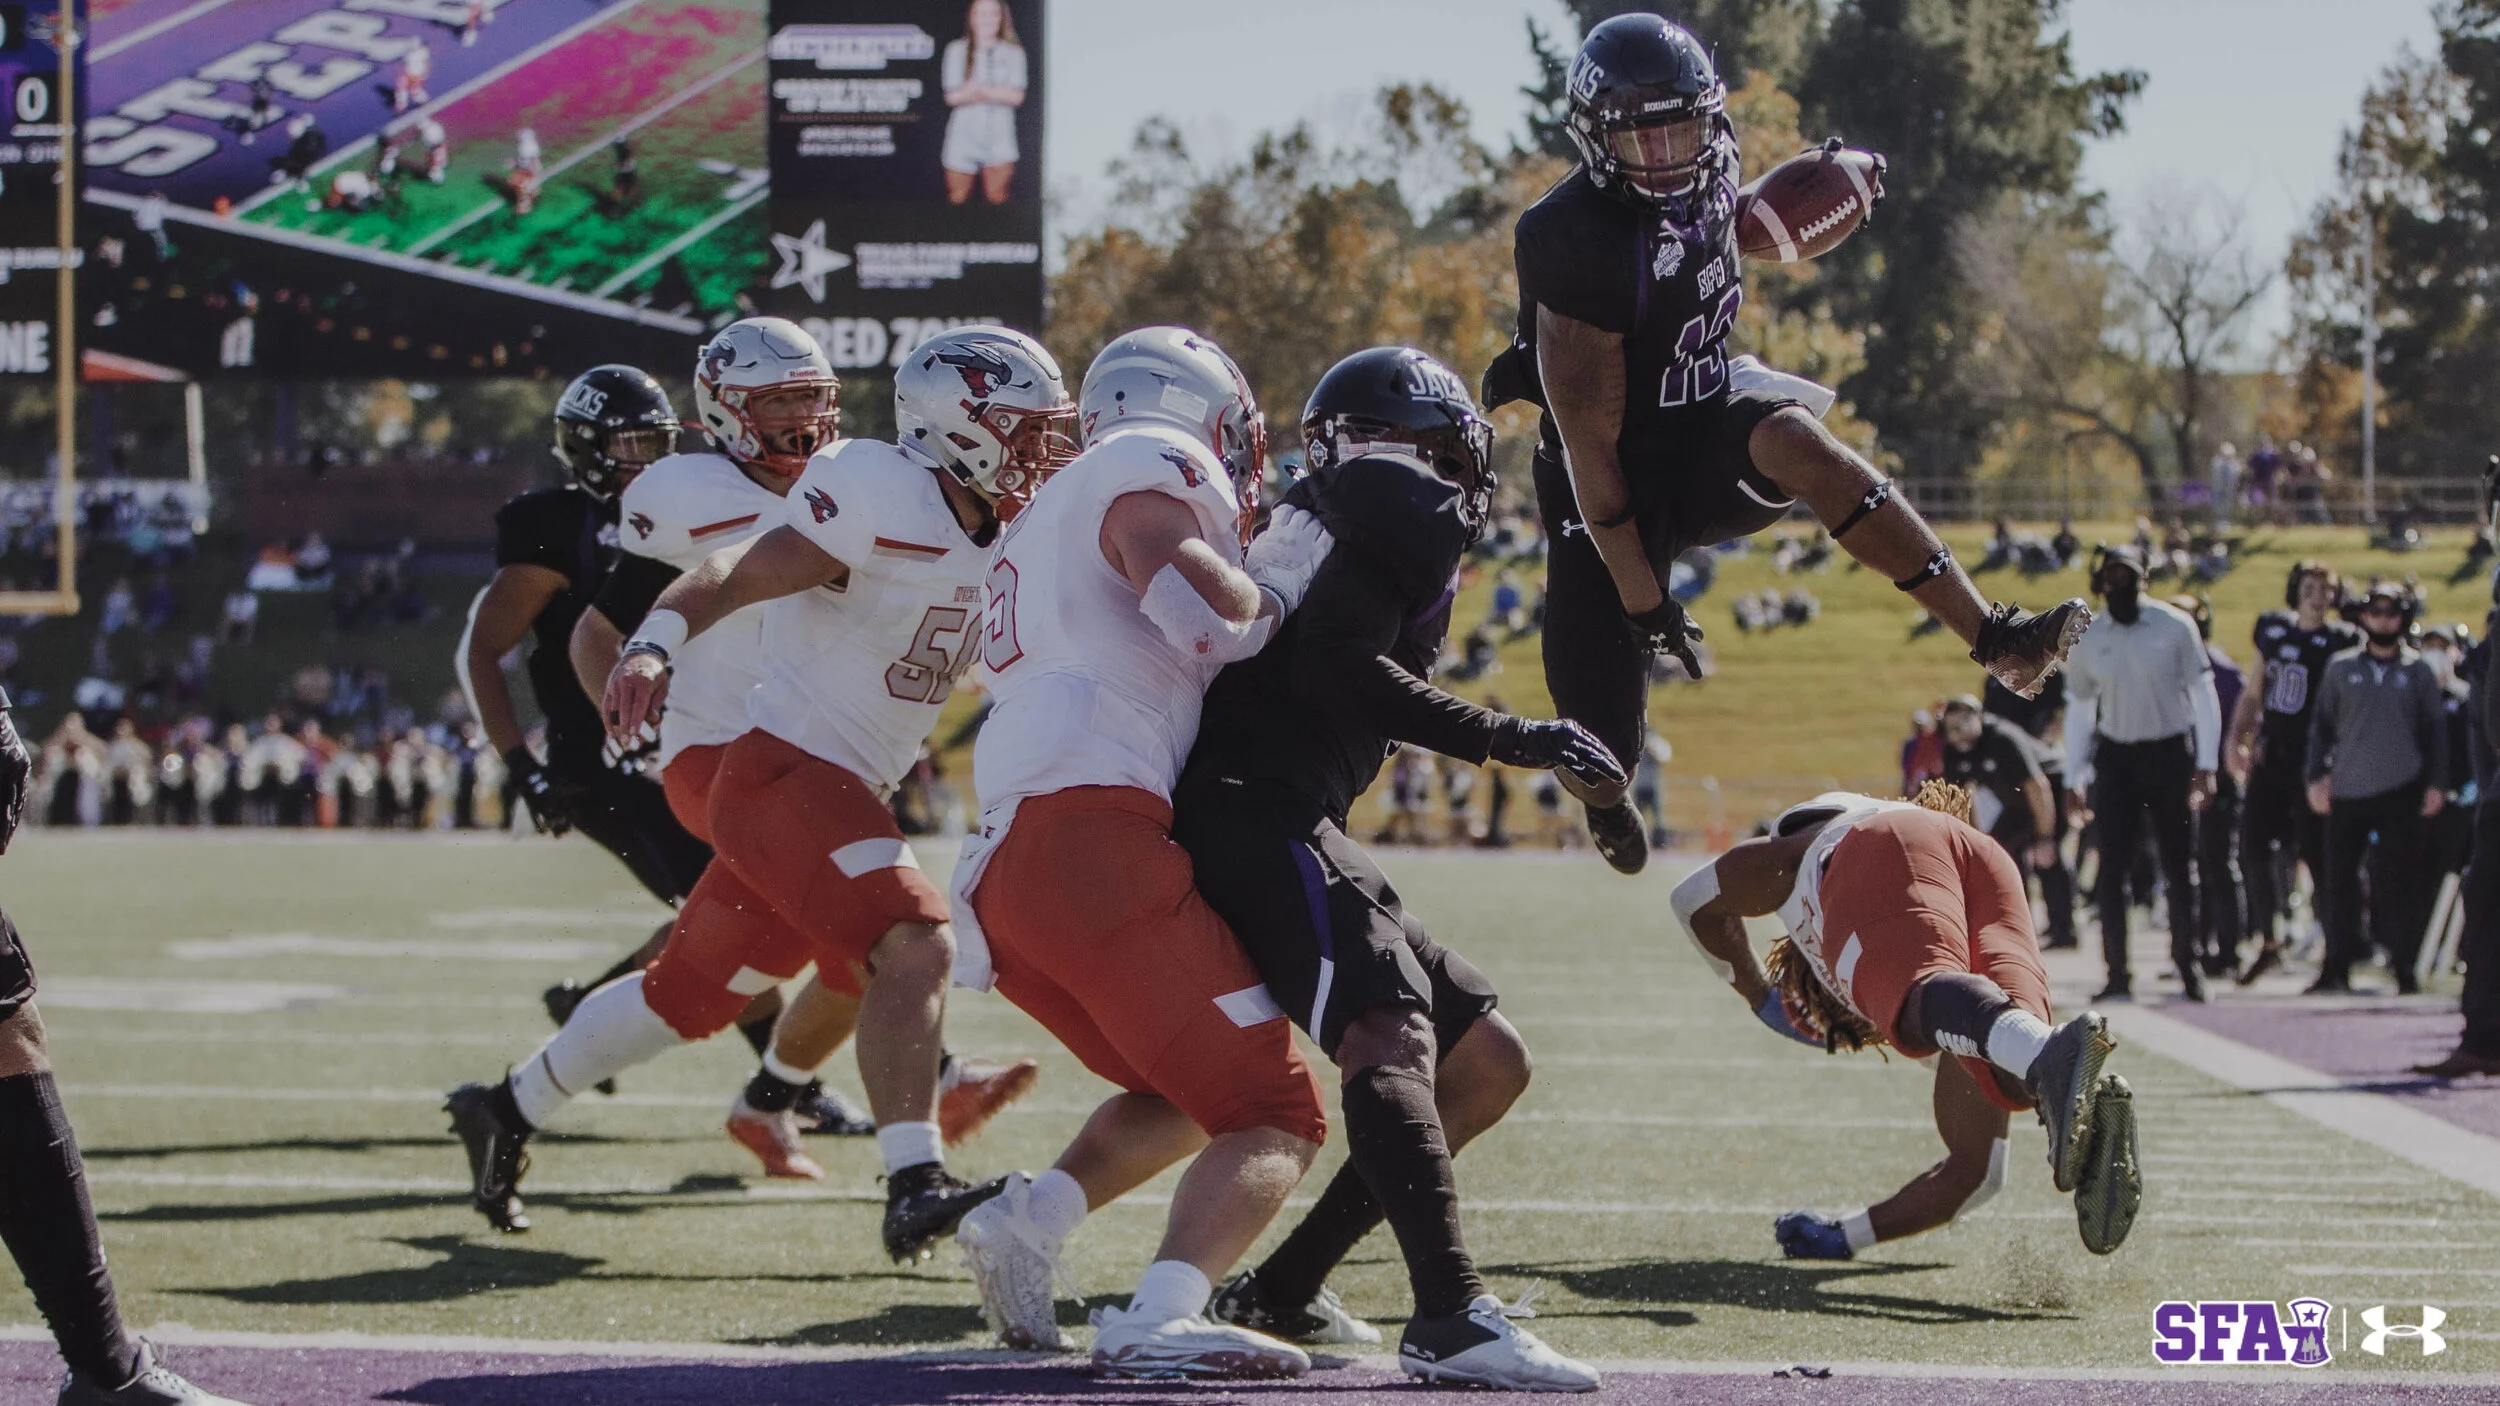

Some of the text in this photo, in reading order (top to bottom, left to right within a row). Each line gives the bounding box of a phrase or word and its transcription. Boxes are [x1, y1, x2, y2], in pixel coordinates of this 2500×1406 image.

[16, 77, 48, 122] 0
[1643, 98, 1683, 113] EQUALITY
[1697, 256, 1725, 300] SFA
[802, 316, 888, 368] RED
[1118, 405, 1125, 416] 5
[1325, 419, 1334, 438] 9
